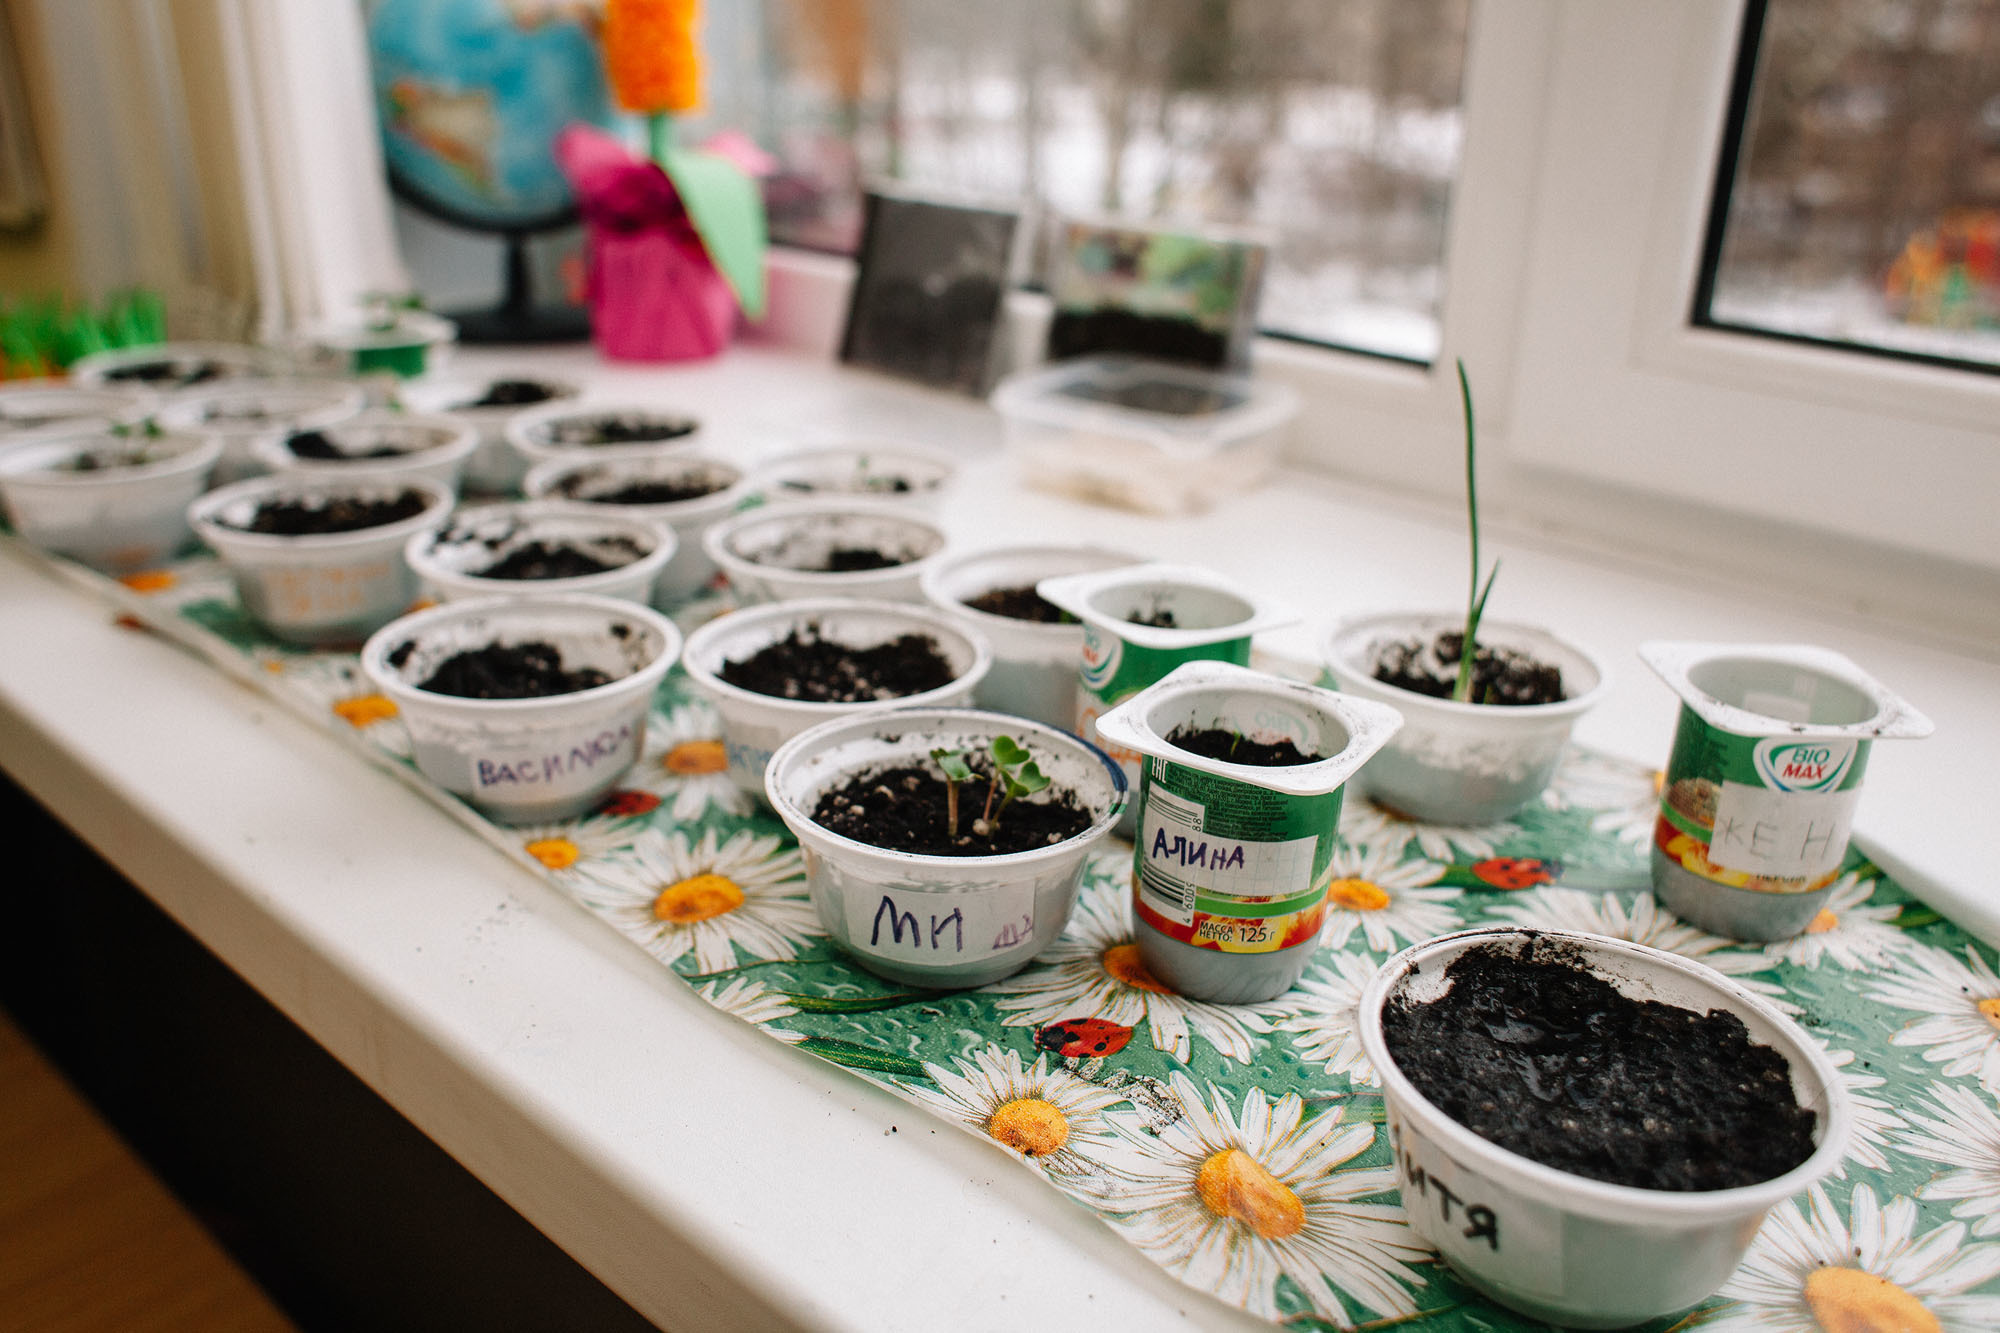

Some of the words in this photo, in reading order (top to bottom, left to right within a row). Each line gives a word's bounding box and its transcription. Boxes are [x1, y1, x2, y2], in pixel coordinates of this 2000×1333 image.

[1792, 748, 1830, 764] BIO
[1782, 763, 1828, 779] MAX
[1152, 827, 1245, 871] АЛИНА
[1199, 929, 1233, 942] НЕТТО:
[1239, 927, 1268, 942] 125
[1200, 921, 1233, 934] МАССА
